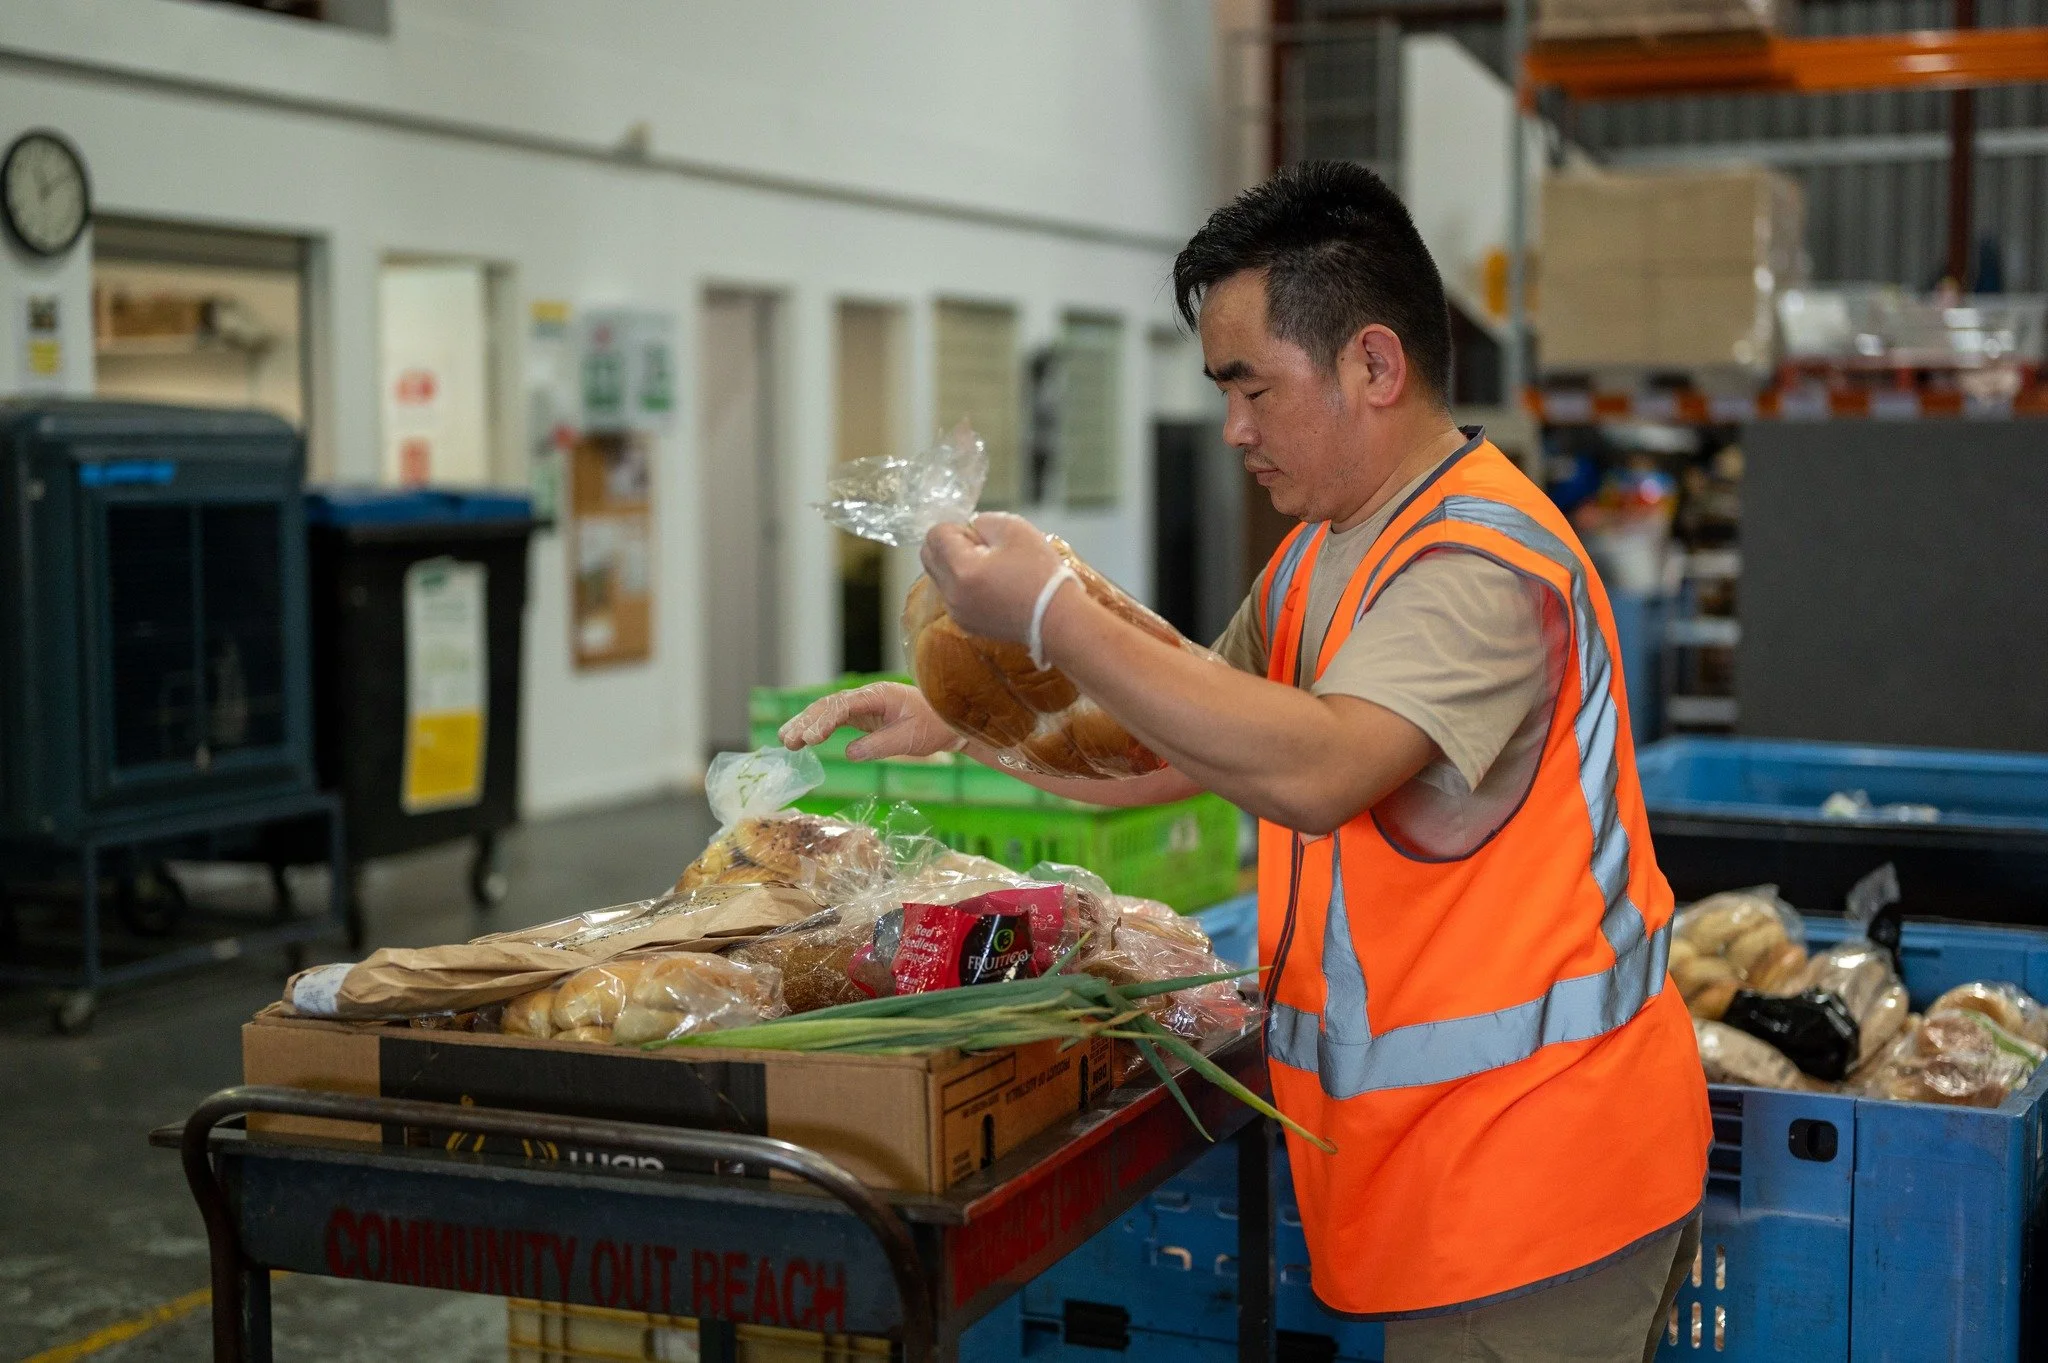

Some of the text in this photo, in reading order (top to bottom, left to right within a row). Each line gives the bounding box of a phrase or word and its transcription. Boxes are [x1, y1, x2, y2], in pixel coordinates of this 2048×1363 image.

[915, 924, 933, 938] Red
[327, 1207, 848, 1332] COMMUNITY OUT REACH
